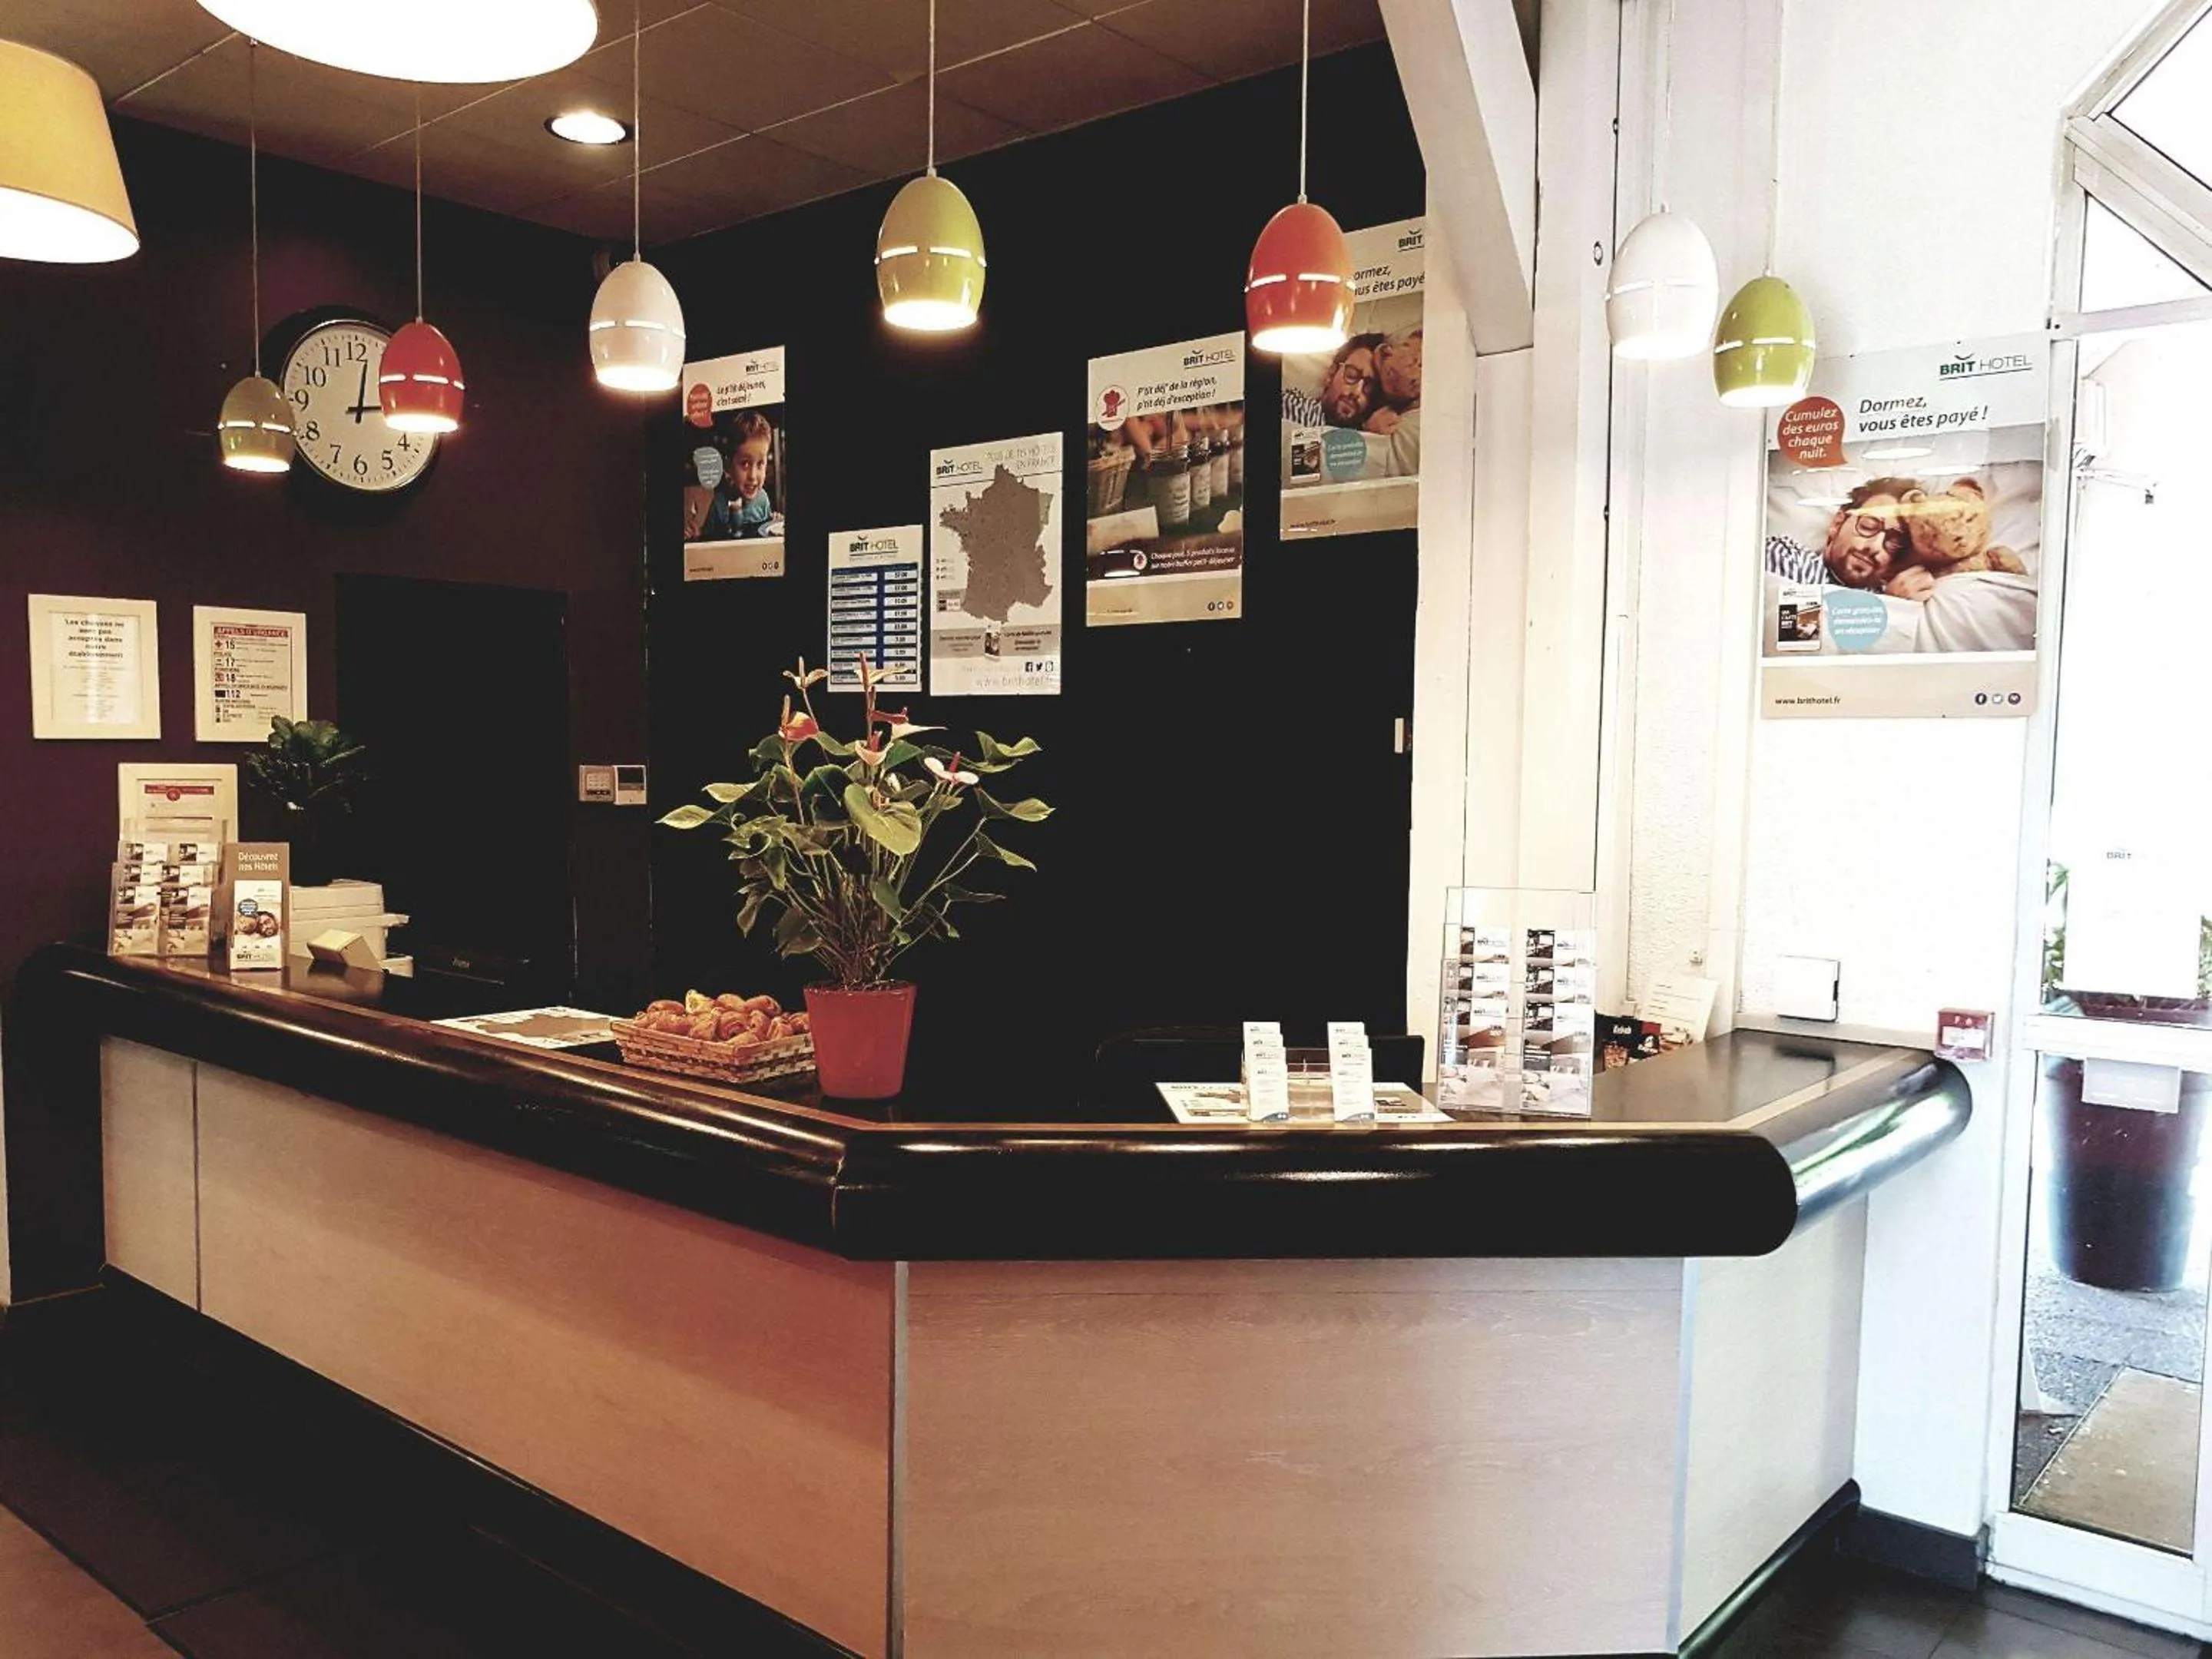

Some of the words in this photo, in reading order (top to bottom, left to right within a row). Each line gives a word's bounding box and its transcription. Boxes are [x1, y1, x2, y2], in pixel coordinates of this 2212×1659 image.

[1399, 234, 1423, 249] BRIT
[1353, 265, 1391, 281] ormez,
[1373, 279, 1395, 293] êtes
[324, 346, 340, 367] 11
[346, 341, 367, 362] 12
[1184, 355, 1204, 366] BRIT
[1205, 349, 1236, 363] HOTEL
[1939, 363, 1975, 376] BRIT
[1979, 356, 2032, 370] HOTEL
[305, 365, 326, 388] 10
[294, 389, 310, 412] 9
[1859, 396, 1927, 413] Dormez,
[1785, 408, 1837, 422] Cumulez
[1859, 419, 1896, 432] vous
[1900, 414, 1934, 429] êtes
[1936, 406, 1978, 427] payé
[305, 420, 320, 442] 8
[1783, 423, 1803, 435] des
[1806, 422, 1839, 433] euros
[397, 433, 410, 452] 4
[1788, 434, 1833, 448] chaque
[329, 444, 341, 463] 7
[381, 450, 393, 470] 5
[1800, 446, 1827, 459] nuit.
[353, 455, 368, 475] 6
[936, 464, 955, 475] BRIT
[956, 461, 982, 472] HOTEL
[849, 542, 869, 552] BRIT
[870, 539, 899, 551] HOTEL
[1775, 697, 1841, 706] www.brithotel.fr
